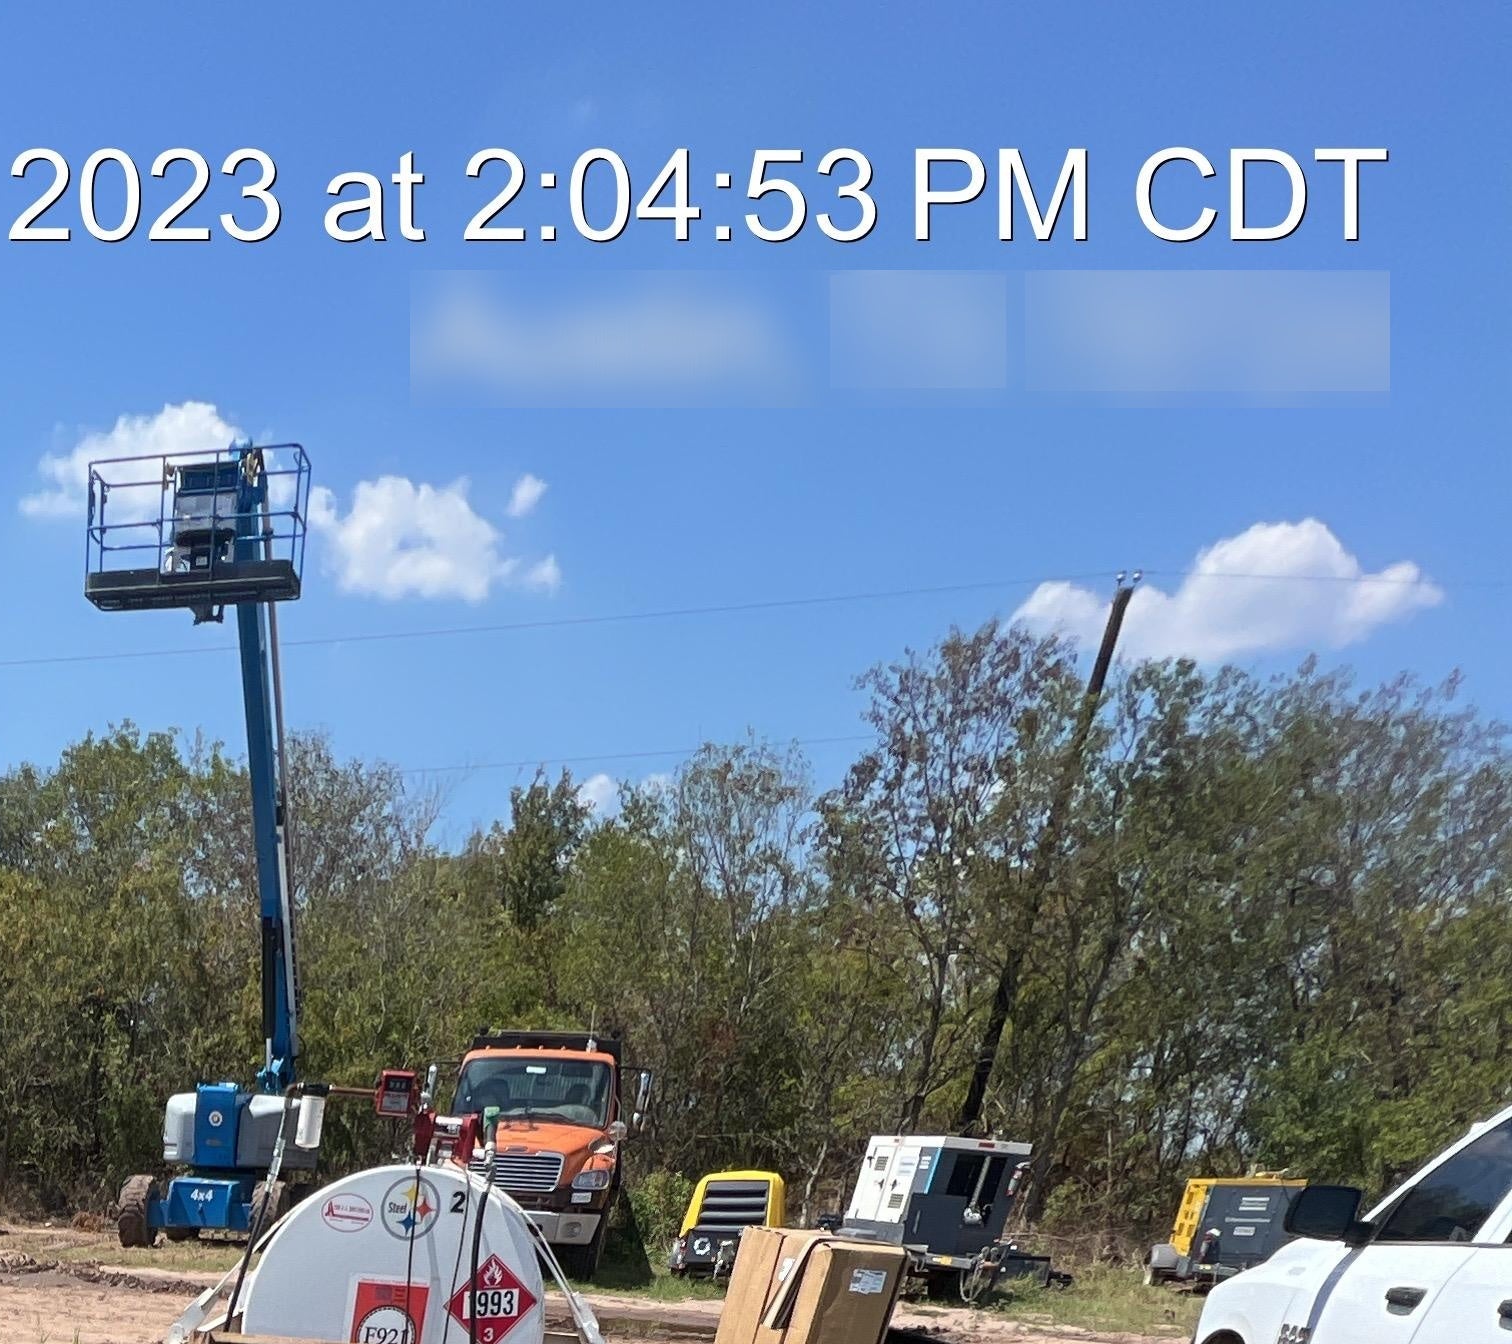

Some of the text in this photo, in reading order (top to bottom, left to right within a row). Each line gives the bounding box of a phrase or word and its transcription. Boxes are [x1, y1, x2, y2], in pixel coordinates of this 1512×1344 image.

[190, 1188, 214, 1202] 4x4
[450, 1190, 466, 1214] 2
[388, 1201, 409, 1215] Steel
[469, 1289, 515, 1318] 993
[483, 1327, 495, 1343] 3
